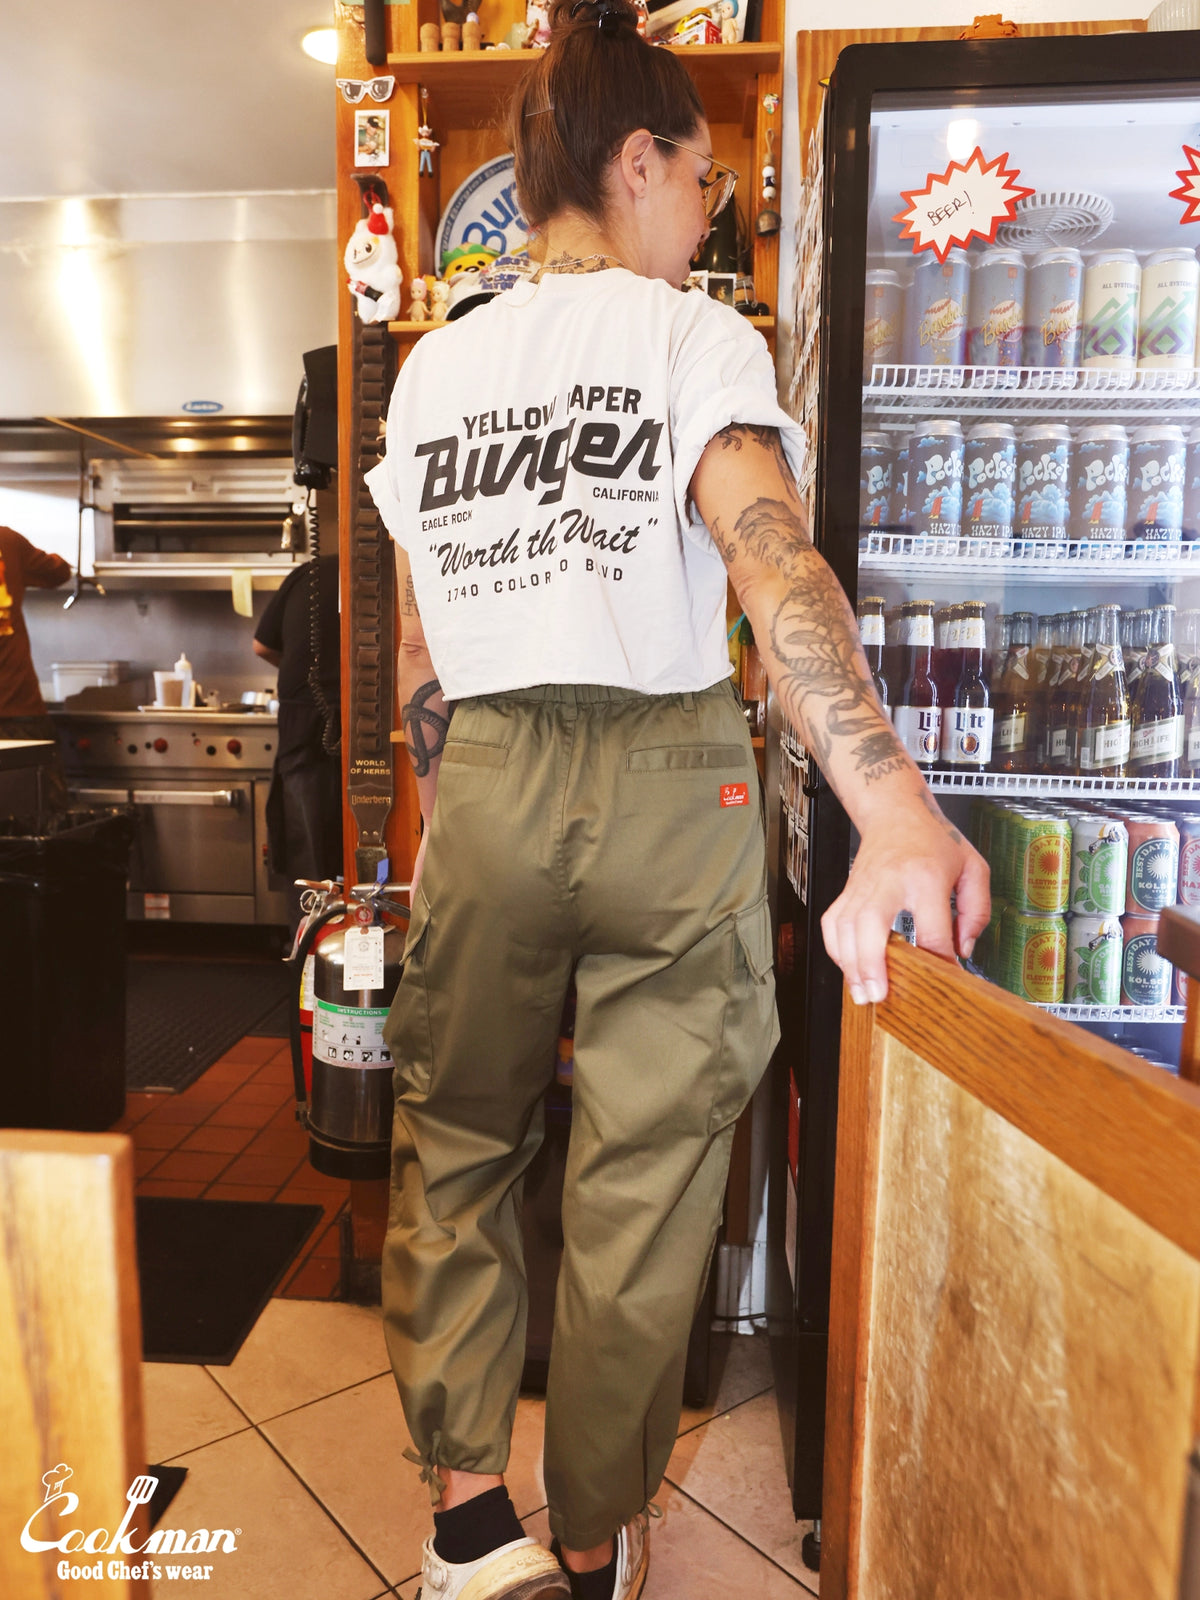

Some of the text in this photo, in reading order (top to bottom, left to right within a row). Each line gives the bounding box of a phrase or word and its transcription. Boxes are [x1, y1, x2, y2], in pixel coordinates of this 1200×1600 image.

[927, 191, 974, 226] BEER!
[566, 384, 642, 415] APER
[414, 417, 664, 513] Burger
[1020, 453, 1070, 491] Pocket
[592, 486, 660, 503] CALIFORNIA
[421, 509, 473, 532] EAGLE ROCK
[930, 523, 956, 535] HAZY
[971, 525, 999, 537] HAZY
[526, 518, 557, 556] th
[1021, 526, 1067, 539] HAZY IPA
[1090, 527, 1119, 540] HAZY
[1145, 528, 1174, 540] HAZY
[447, 584, 480, 603] 1740
[493, 558, 568, 594] COLORO
[955, 711, 986, 732] Lite
[350, 767, 391, 776] OF HERBS
[355, 759, 386, 767] WORLD
[1135, 842, 1162, 879] BEST DAY
[1126, 938, 1151, 973] BEST DAY
[337, 1007, 382, 1016] INSTRUCTIONS
